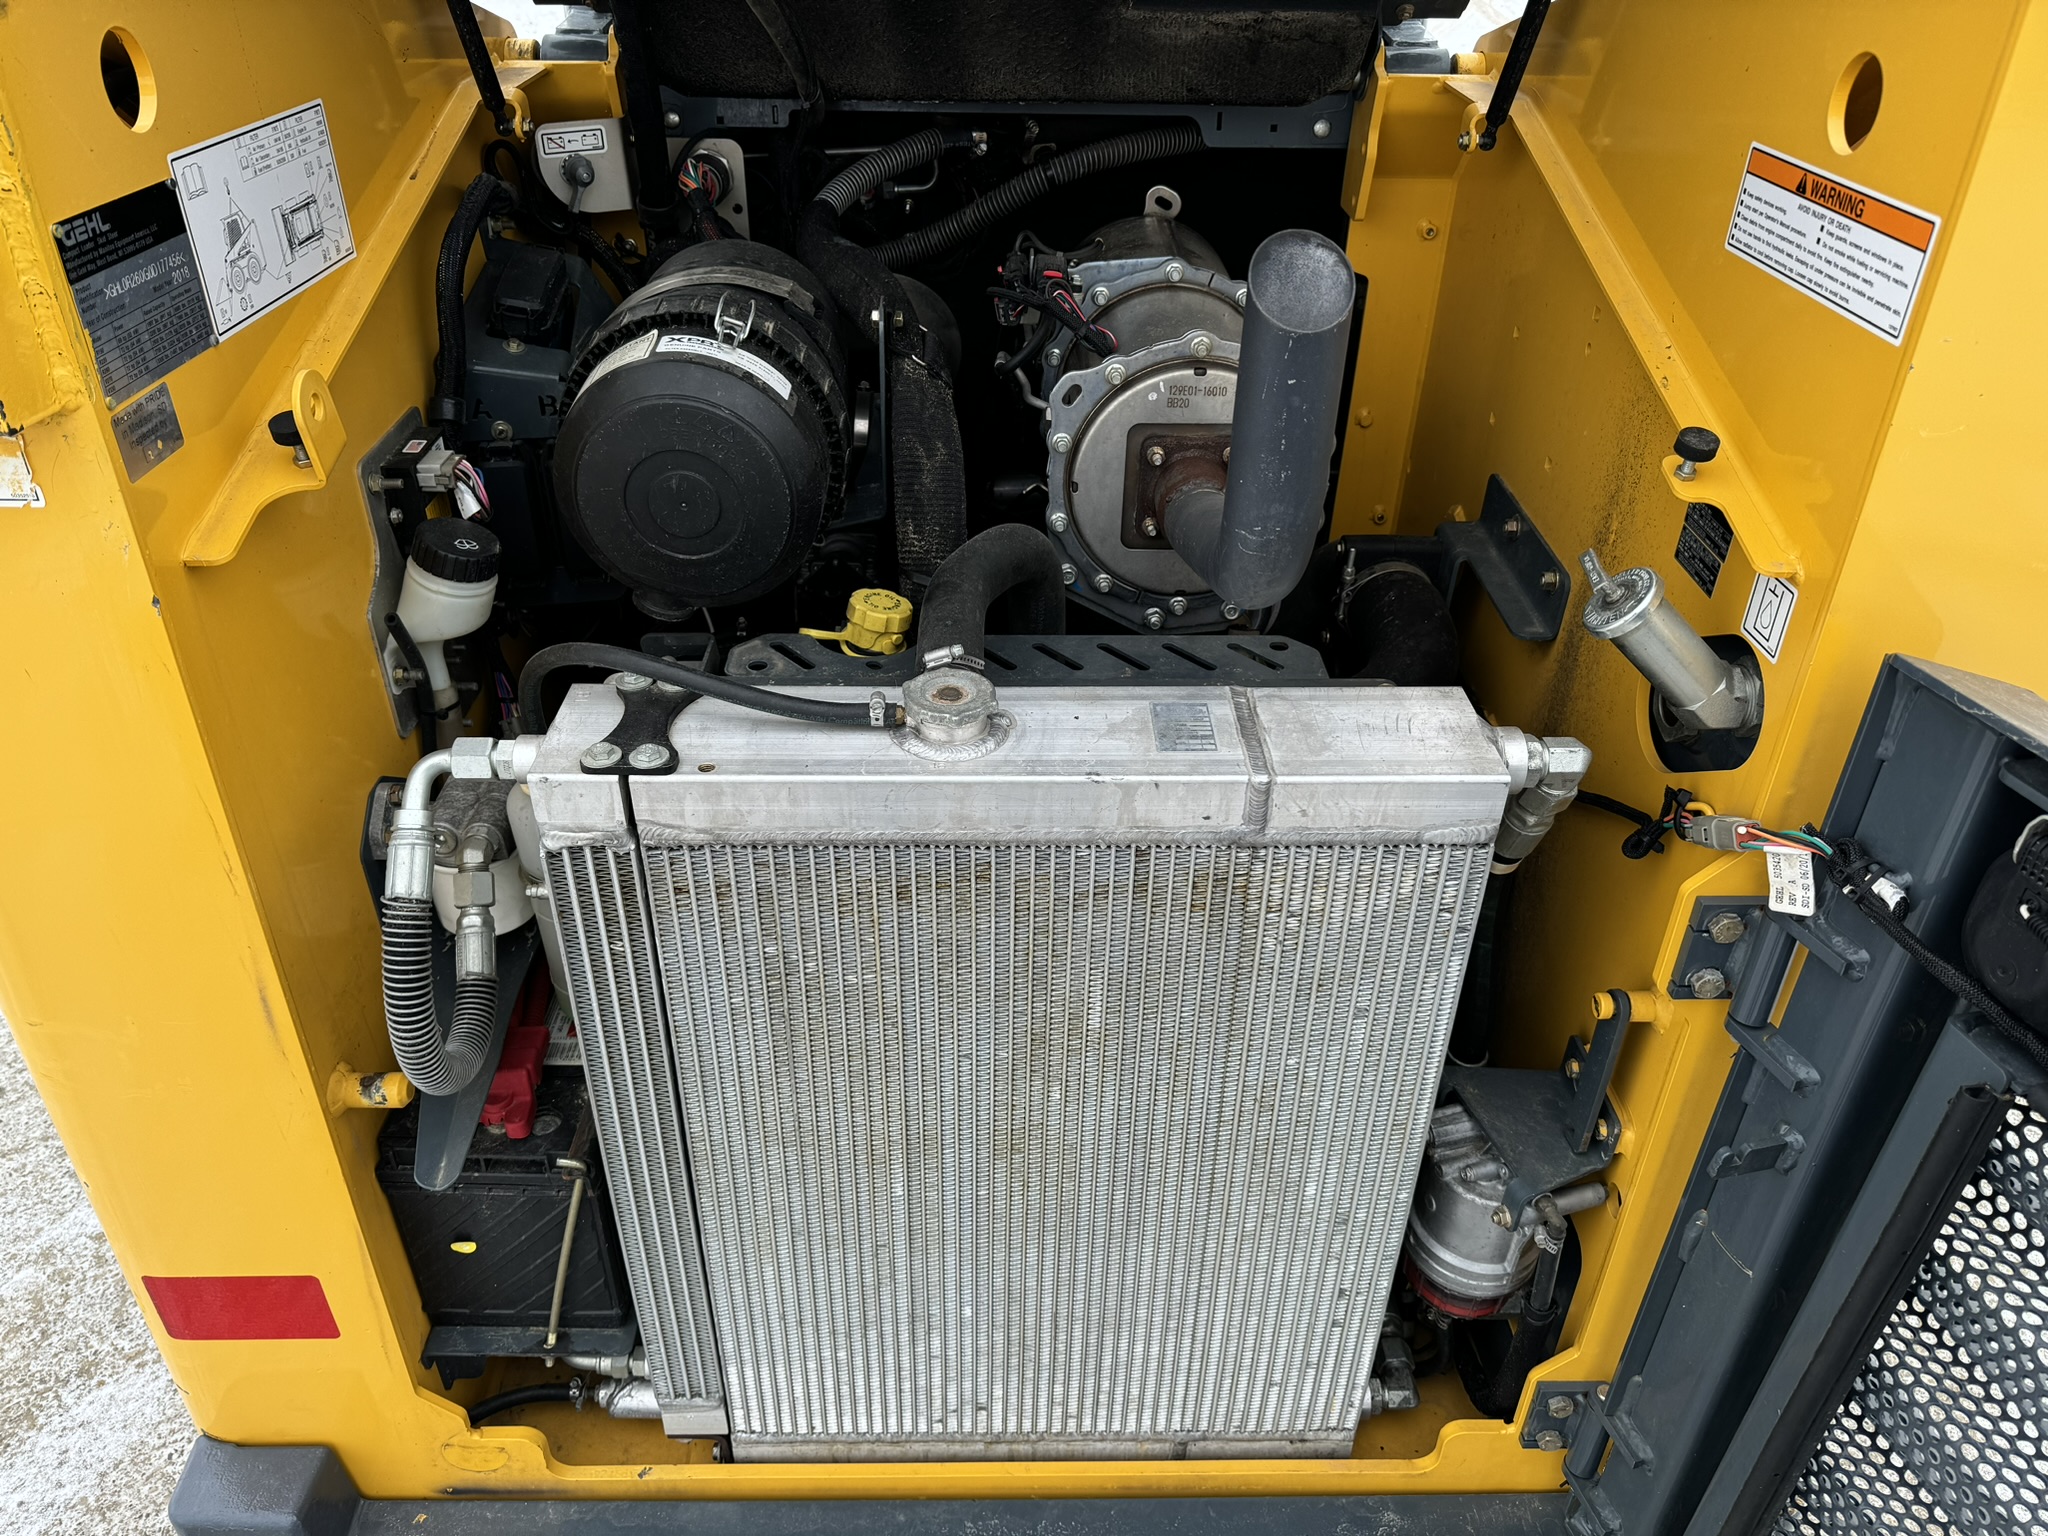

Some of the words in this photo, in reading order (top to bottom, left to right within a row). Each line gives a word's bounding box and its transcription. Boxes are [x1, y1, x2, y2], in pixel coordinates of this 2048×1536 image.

[1808, 179, 1866, 218] WARNING
[1797, 203, 1810, 214] AVOID
[1810, 209, 1827, 222] INJURY
[1827, 217, 1835, 226] OR
[1835, 220, 1851, 233] DEATH
[61, 211, 108, 245] GEHL
[171, 265, 190, 284] 2018
[74, 282, 91, 295] Product
[85, 316, 97, 328] Year
[100, 302, 125, 319] Construction
[1167, 384, 1228, 397] 129E01-16010
[113, 411, 132, 428] Made
[132, 402, 145, 417] with
[145, 387, 165, 407] PRIDE
[1166, 397, 1190, 409] BB20
[1775, 886, 1784, 905] GEHL
[1788, 891, 1797, 907] REV
